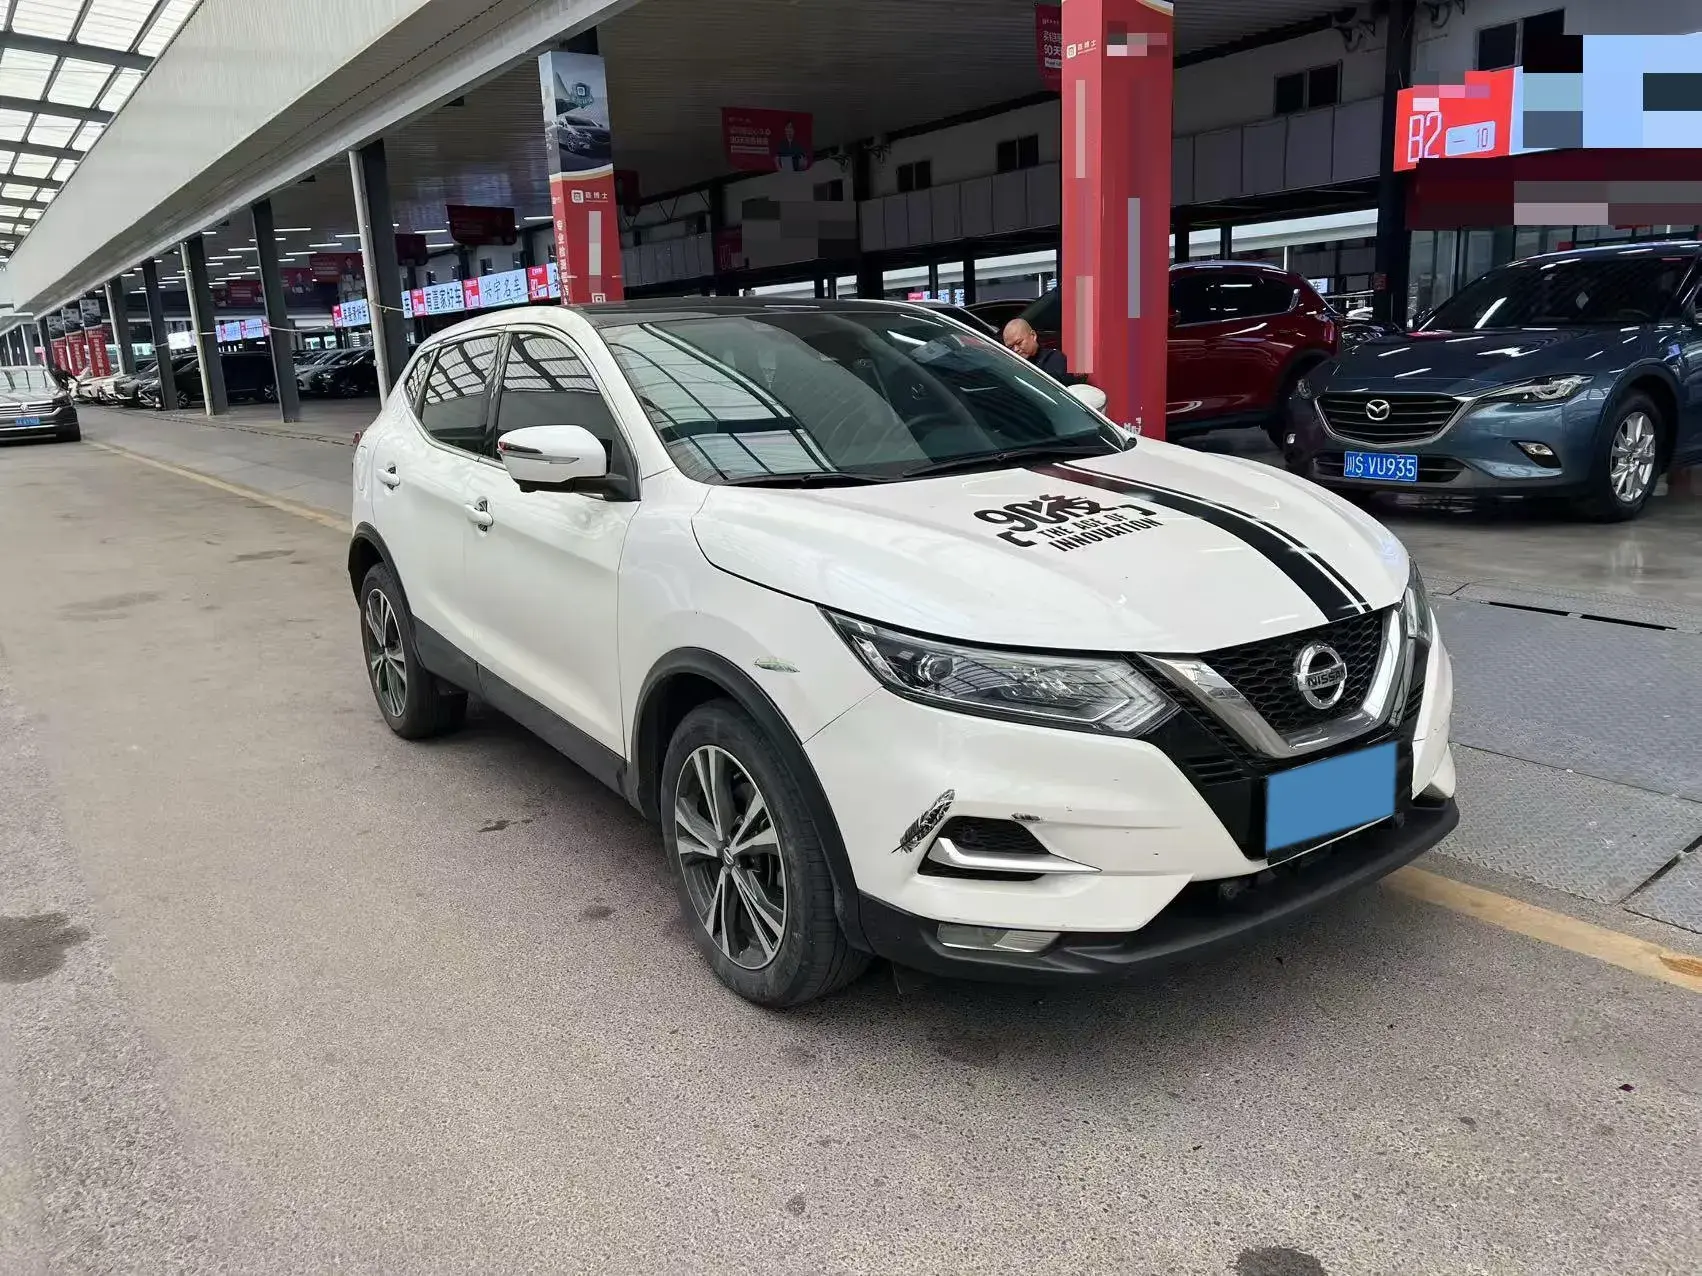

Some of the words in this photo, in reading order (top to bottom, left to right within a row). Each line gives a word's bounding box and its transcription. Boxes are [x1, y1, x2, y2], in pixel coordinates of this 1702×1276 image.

[1408, 112, 1442, 163] B2
[1036, 525, 1074, 539] THE
[1072, 517, 1108, 532] AGE
[1107, 512, 1129, 524] OF
[1048, 518, 1165, 552] INNOVATION
